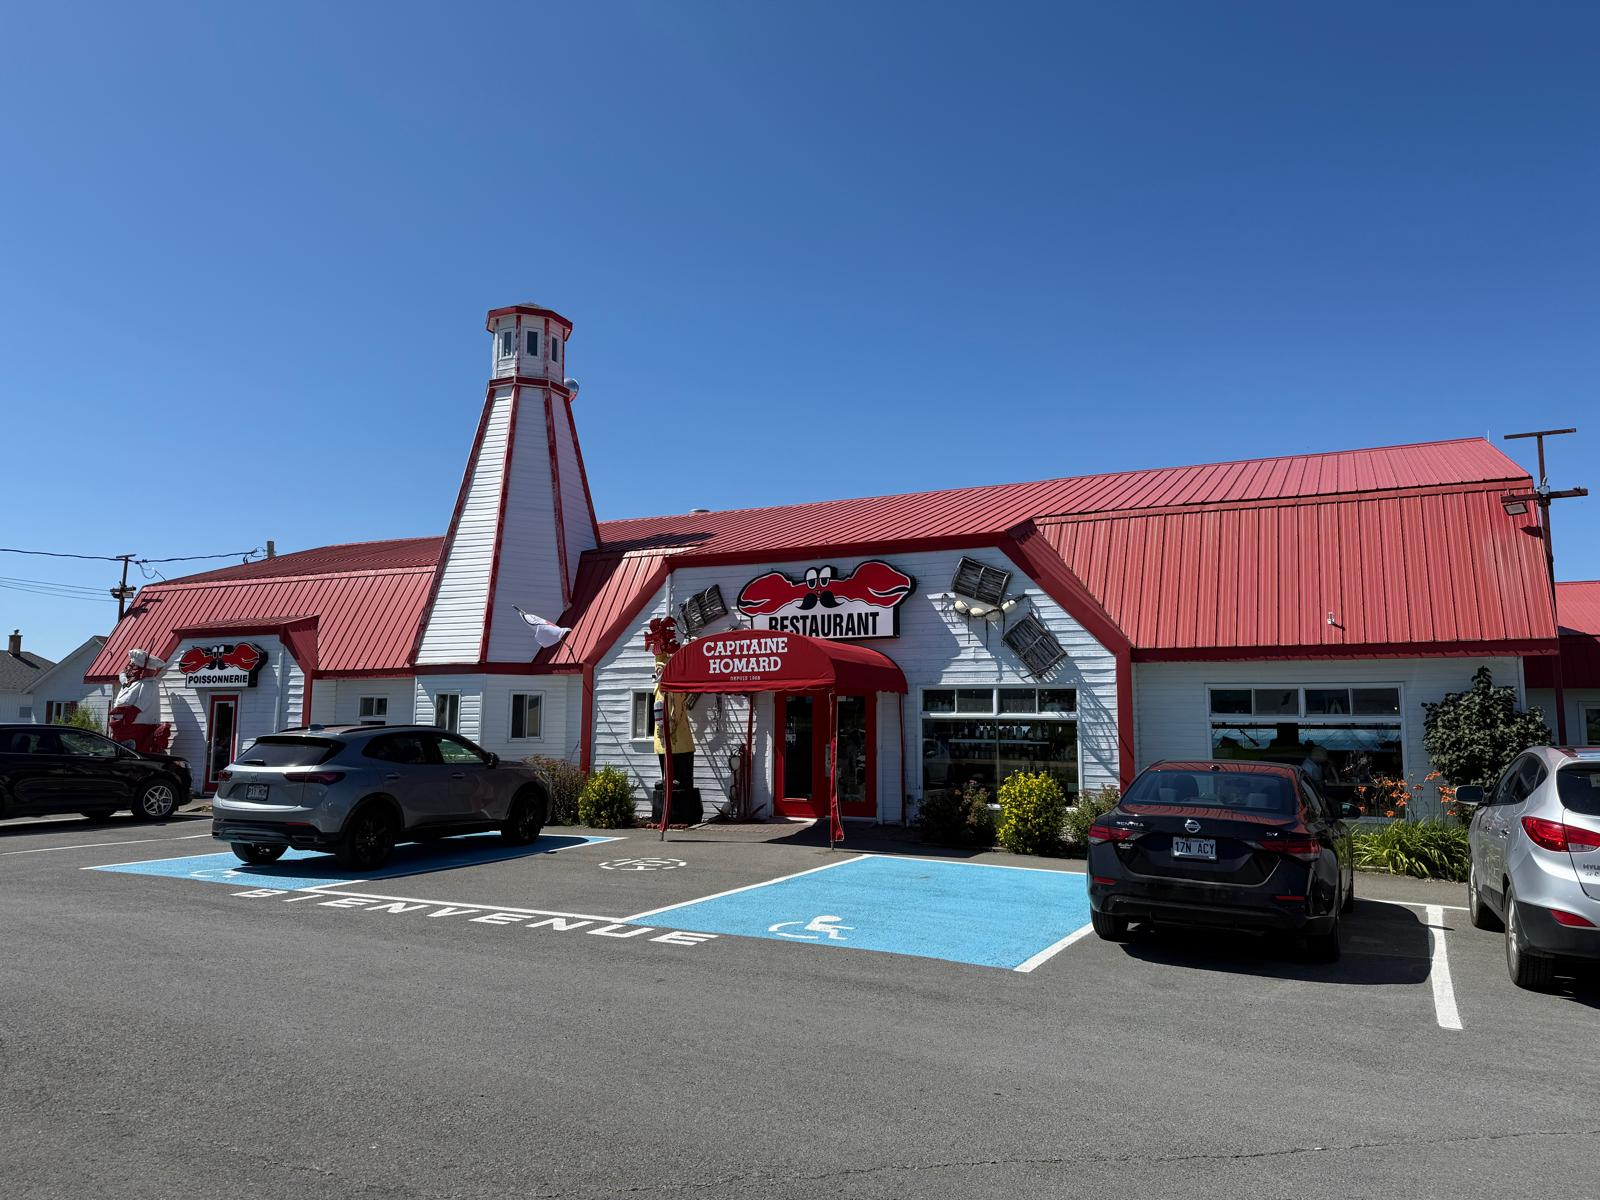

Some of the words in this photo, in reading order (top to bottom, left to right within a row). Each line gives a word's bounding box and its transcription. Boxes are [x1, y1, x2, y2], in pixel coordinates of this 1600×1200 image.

[769, 612, 879, 637] RESTAURANT
[703, 637, 788, 656] CAPITAINE
[709, 656, 782, 673] HOMARD
[188, 675, 248, 684] POISSONNERIE
[1175, 841, 1192, 853] 17N
[1197, 843, 1215, 855] ACY
[231, 887, 719, 946] BIENVENUE
